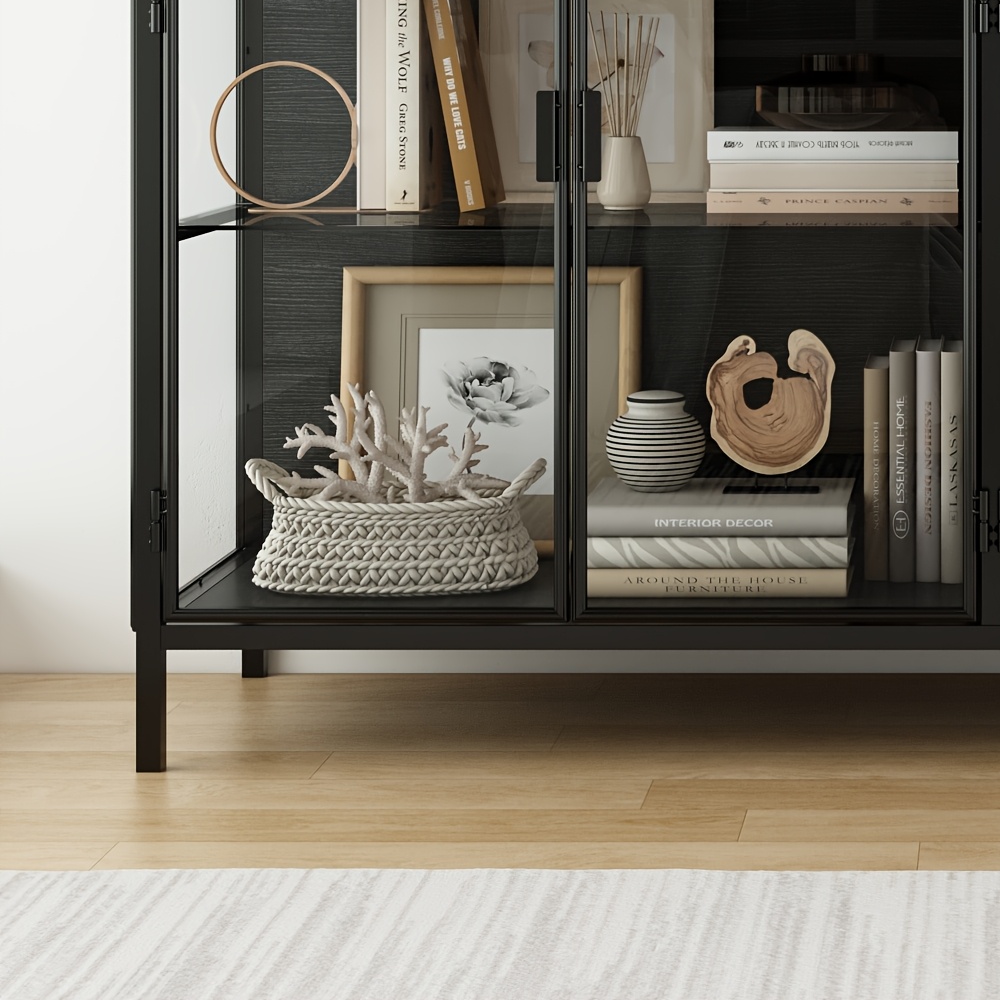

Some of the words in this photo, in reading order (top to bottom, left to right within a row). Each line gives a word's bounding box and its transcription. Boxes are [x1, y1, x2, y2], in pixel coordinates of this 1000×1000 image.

[397, 32, 408, 48] the
[397, 51, 411, 93] WOLF
[443, 56, 453, 77] WHY
[446, 78, 456, 91] DO
[449, 92, 459, 106] WE
[398, 103, 409, 133] GREG
[452, 106, 462, 128] LOVE
[455, 128, 466, 151] CATS
[398, 136, 409, 171] STONE
[895, 396, 905, 438] HOME
[949, 414, 958, 507] LASKASAS
[895, 440, 905, 504] ESSENTIAL
[924, 475, 932, 535] DESIGN
[654, 518, 722, 528] INTERIOR
[725, 518, 774, 528] DECOR
[623, 576, 699, 585] AROUND
[705, 576, 741, 585] THE
[749, 576, 808, 585] HOUSE
[665, 585, 767, 593] FURNITURE
